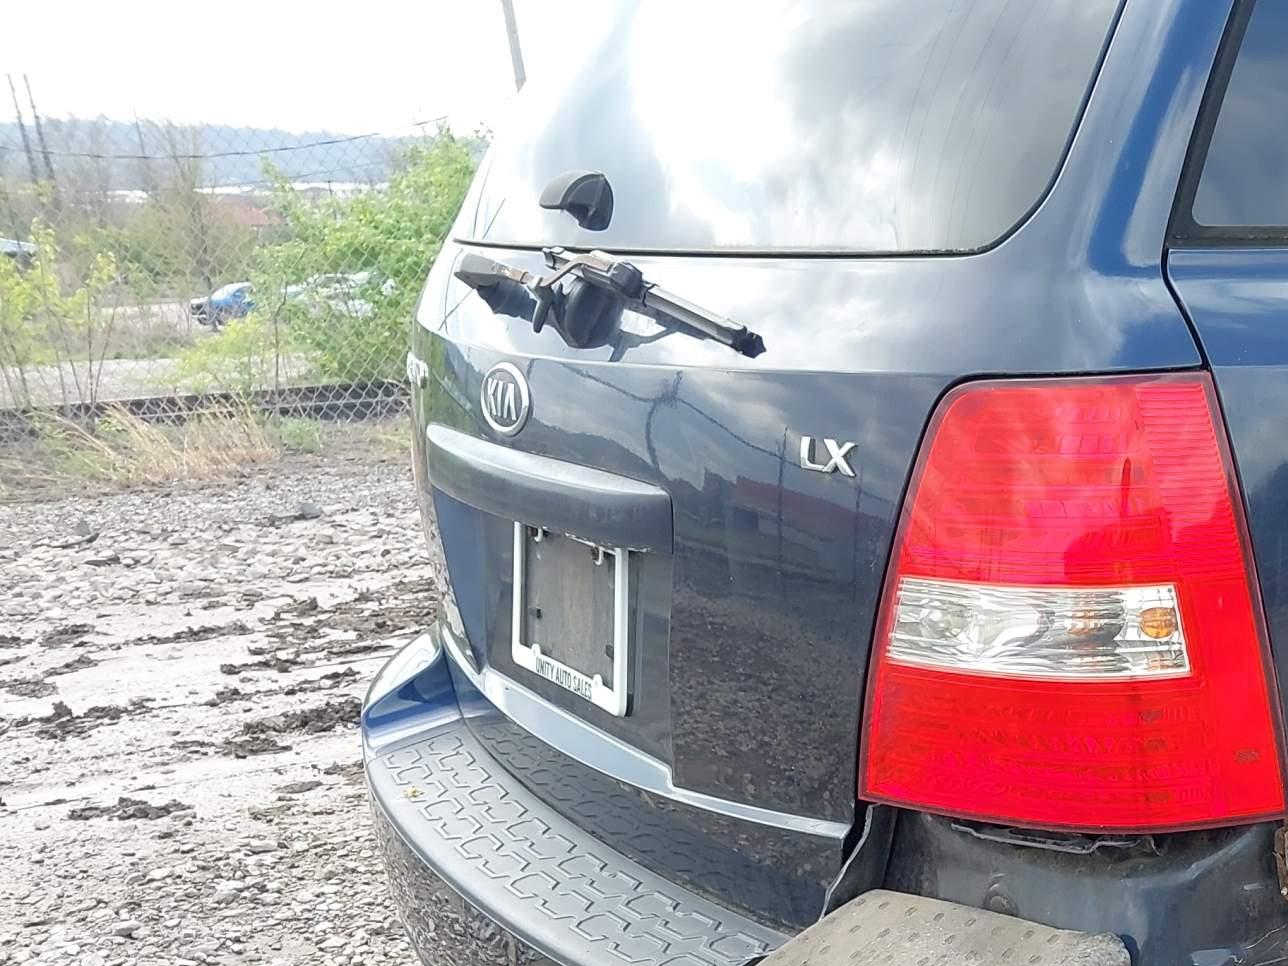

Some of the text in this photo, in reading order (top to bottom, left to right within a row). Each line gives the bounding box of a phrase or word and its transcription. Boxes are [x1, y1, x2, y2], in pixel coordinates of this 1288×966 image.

[488, 377, 517, 421] KIA
[801, 436, 857, 477] LX
[535, 656, 593, 700] UNITY AUTO SALES
